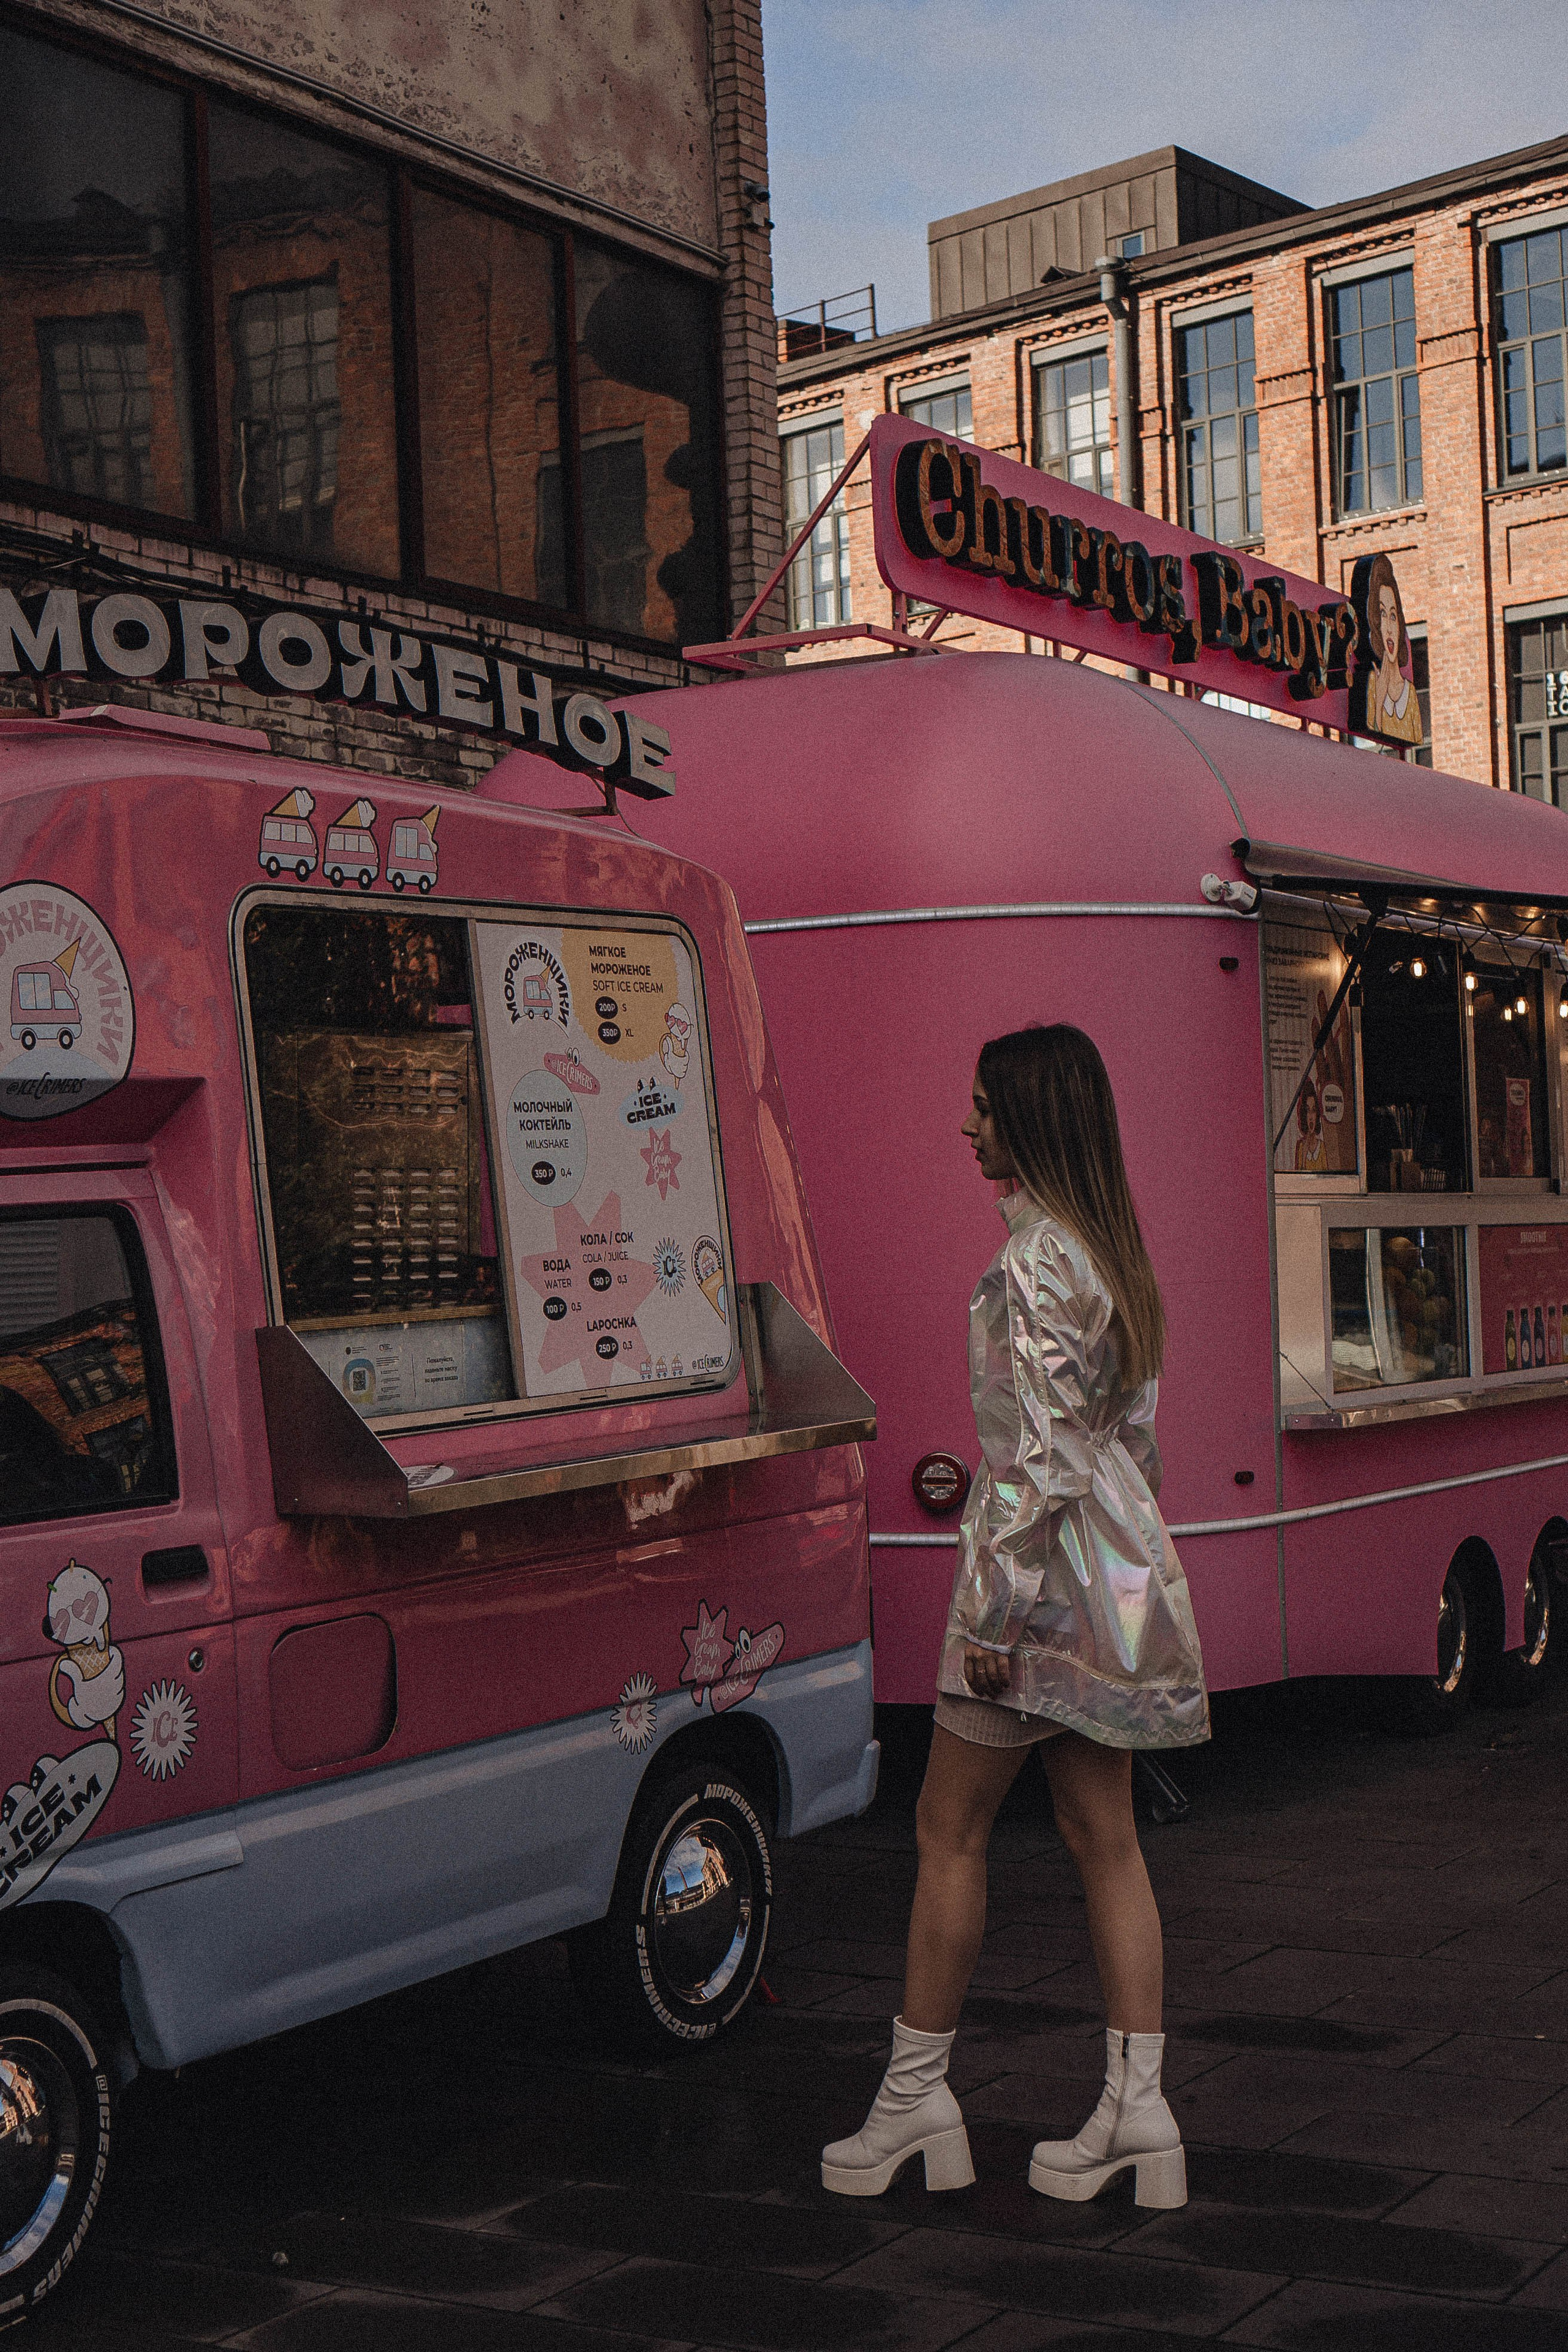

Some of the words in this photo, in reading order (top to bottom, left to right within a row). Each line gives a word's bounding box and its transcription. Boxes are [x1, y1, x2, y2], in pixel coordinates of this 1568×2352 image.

[895, 438, 1202, 663] Churros,
[0, 588, 676, 800] МОРОЖЕНОЕ
[589, 945, 626, 959] МЯГКОЕ
[590, 963, 651, 976] МОРОЖЕНОЕ
[0, 899, 124, 1066] ЖЕНЩИКИ
[504, 941, 570, 1028] МОРОЖЕНЩИКИ
[593, 980, 615, 992] SOFT
[617, 981, 631, 992] ICE
[633, 982, 664, 993] CREAM
[622, 1003, 627, 1012] S
[625, 1028, 634, 1037] XL
[6, 1072, 87, 1100] @ICECRIMERS
[513, 1098, 573, 1114] МОЛОЧНЫЙ
[638, 1092, 662, 1108] ICE
[627, 1102, 676, 1124] CREAM
[519, 1115, 571, 1131] КОКТЕЙЛЬ
[526, 1139, 570, 1150] MILKSHAKE
[535, 1169, 547, 1178] 350
[560, 1167, 572, 1178] 0,4
[580, 1234, 607, 1246] КОЛА
[614, 1232, 634, 1244] СОК
[582, 1253, 603, 1263] COLA
[607, 1251, 629, 1262] JUICE
[543, 1259, 571, 1272] ВОДА
[544, 1278, 572, 1290] WATER
[593, 1277, 604, 1286] 150
[617, 1275, 628, 1284] 0,3
[546, 1305, 558, 1314] 100
[571, 1303, 581, 1312] 0,5
[587, 1317, 637, 1332] LAPOCHKA
[599, 1343, 611, 1352] 250
[622, 1341, 633, 1351] 0,3
[701, 1618, 717, 1641] Ice
[694, 1637, 721, 1660] Cream
[693, 1656, 717, 1683] Baby
[151, 1710, 178, 1749] ICE
[9, 1782, 66, 1852] ICE
[704, 1783, 773, 1897] МОРОЖЕНЩИКИ
